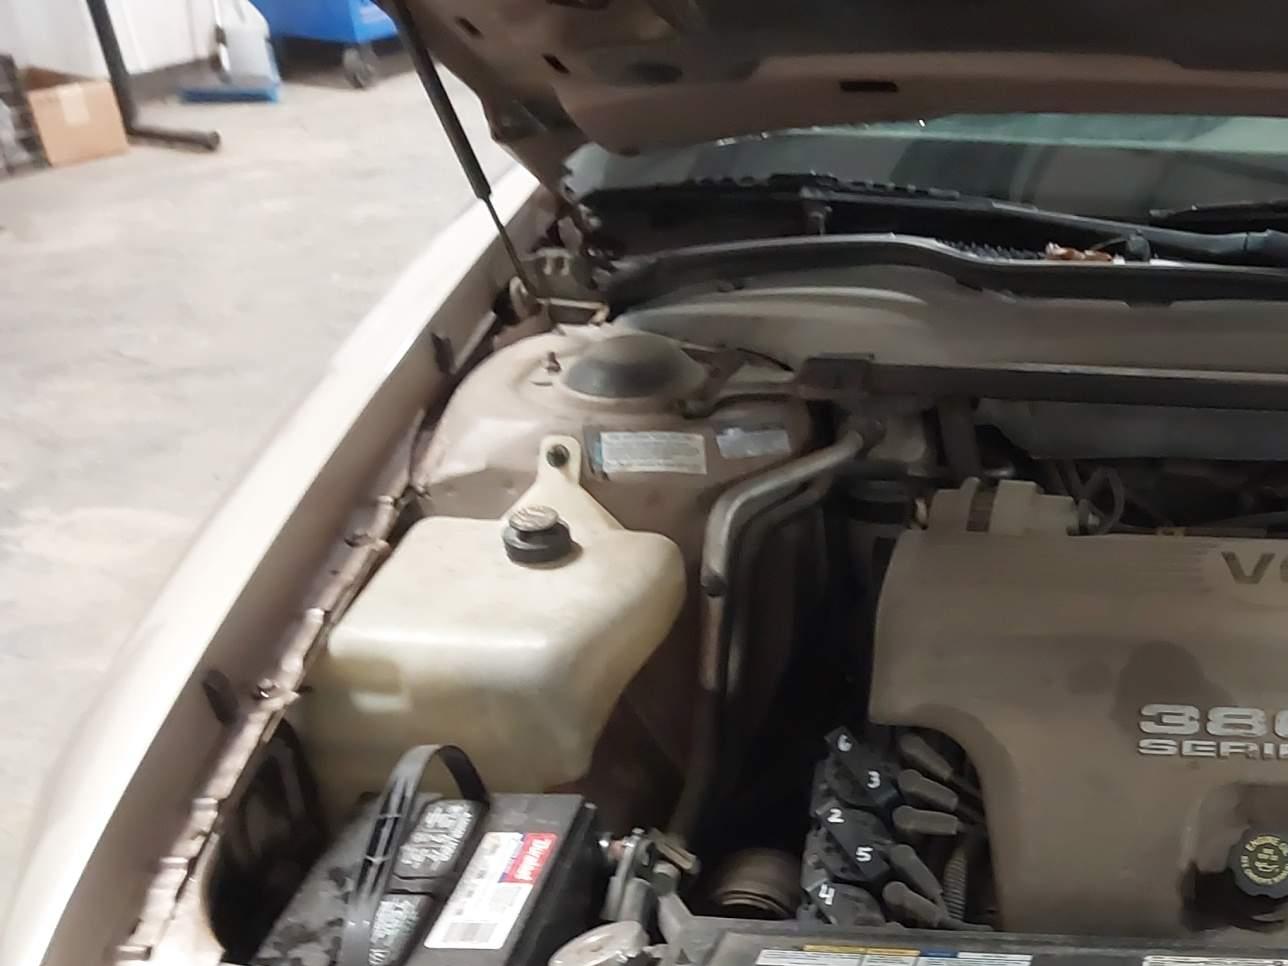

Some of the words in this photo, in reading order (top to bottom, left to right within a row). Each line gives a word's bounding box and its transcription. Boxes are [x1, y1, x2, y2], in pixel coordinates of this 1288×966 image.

[837, 733, 853, 752] 6
[866, 770, 882, 789] 3
[826, 808, 846, 824] 2
[855, 846, 874, 862] 5
[818, 884, 836, 905] 4
